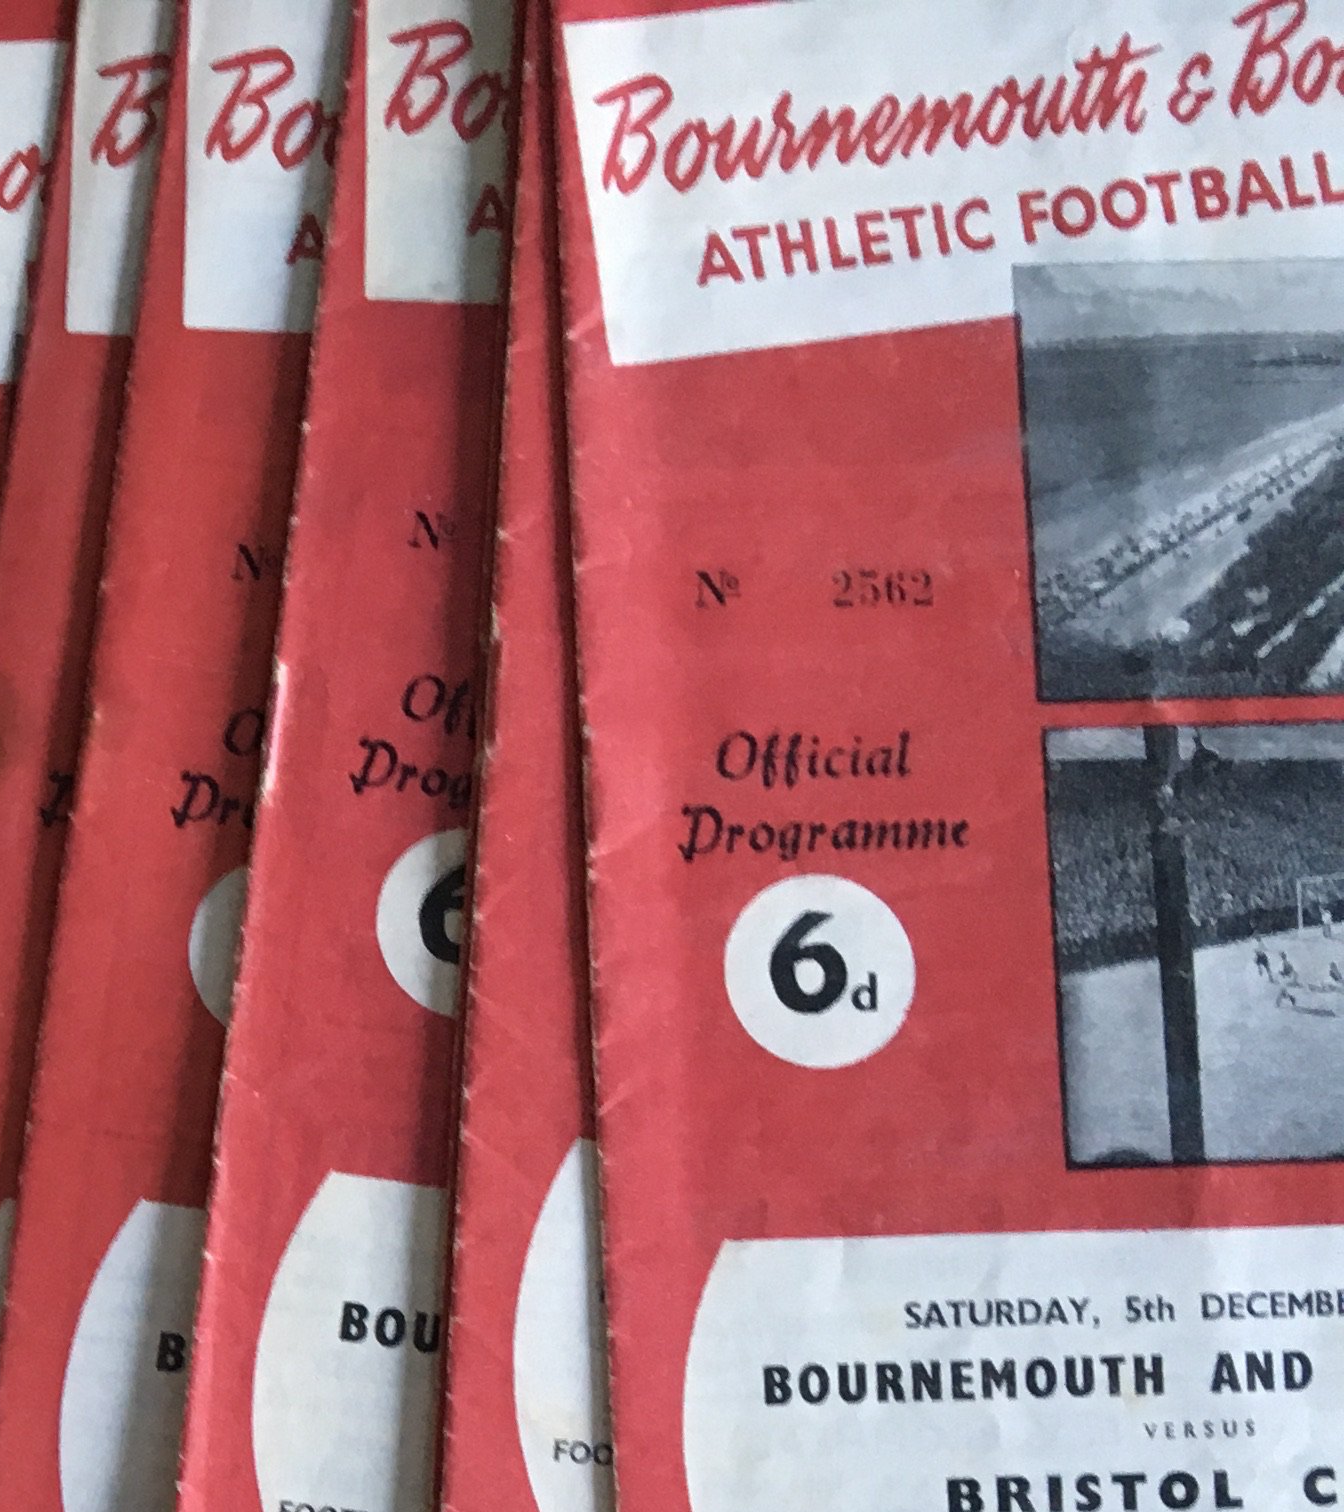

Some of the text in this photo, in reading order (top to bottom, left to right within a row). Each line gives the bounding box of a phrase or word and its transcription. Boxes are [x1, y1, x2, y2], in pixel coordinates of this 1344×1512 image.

[593, 32, 1216, 194] Bournemouth &
[695, 198, 995, 288] ATHLETIC
[831, 570, 935, 610] 2562
[714, 730, 912, 789] Official
[677, 802, 971, 865] Programme
[904, 1293, 1176, 1333] SATURDAY, 5th
[762, 1349, 1314, 1407] BOURNEMOUTH AND
[1143, 1418, 1256, 1440] VERSUS
